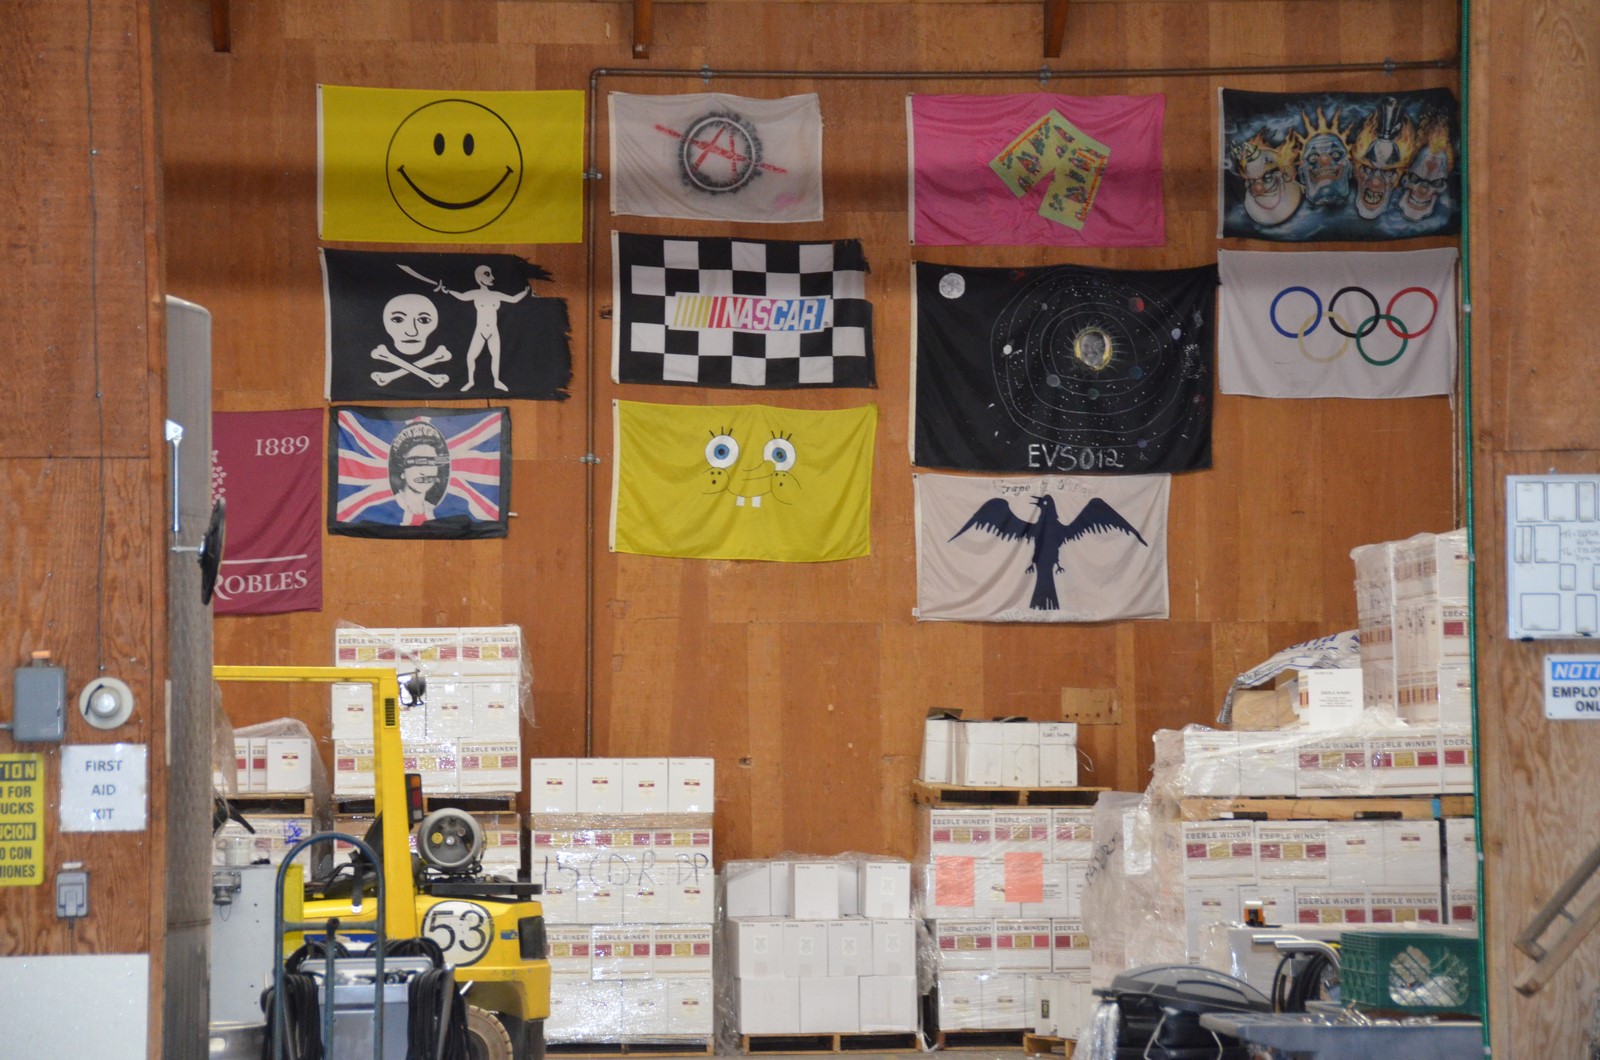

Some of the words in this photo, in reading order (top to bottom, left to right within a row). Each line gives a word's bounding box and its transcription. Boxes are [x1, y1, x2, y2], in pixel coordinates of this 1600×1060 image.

[721, 297, 819, 331] NASCAR
[255, 436, 309, 456] 1889
[213, 570, 308, 600] ROBLES
[1552, 686, 1600, 698] EMPLO
[85, 760, 123, 771] FIRST
[8, 786, 31, 798] FOR
[91, 784, 116, 796] AID
[10, 846, 32, 860] CON
[429, 909, 487, 952] 53
